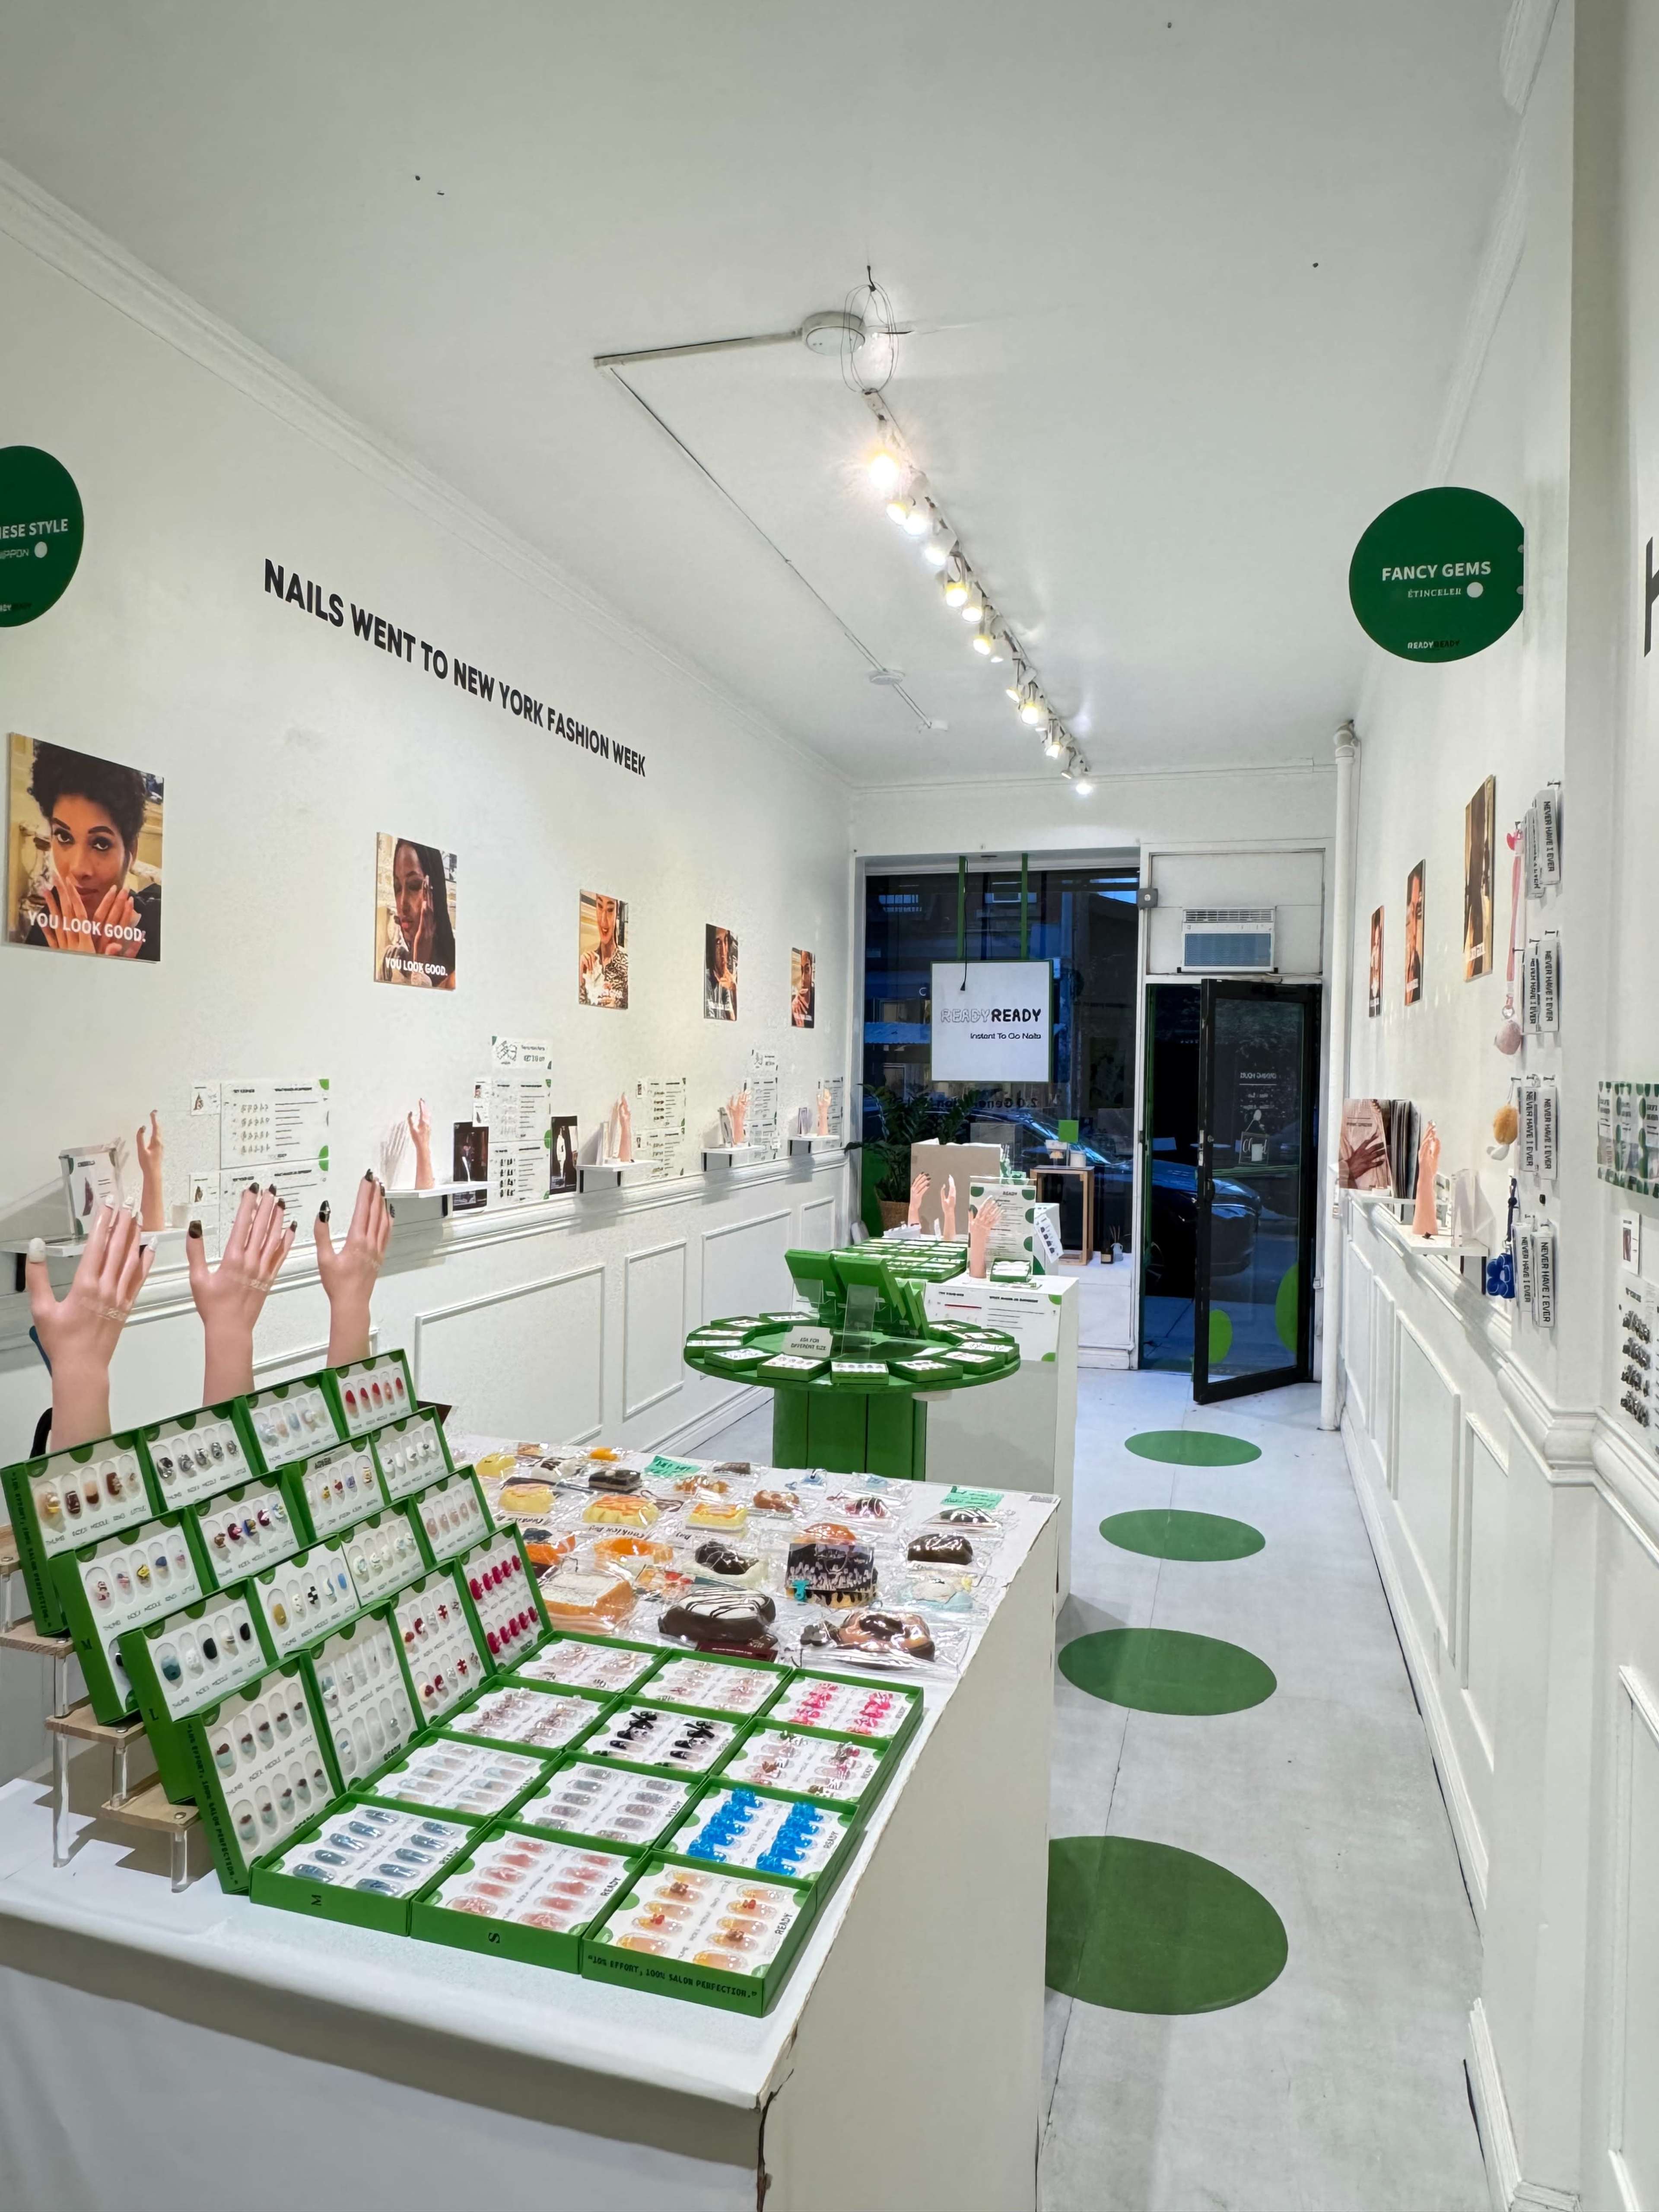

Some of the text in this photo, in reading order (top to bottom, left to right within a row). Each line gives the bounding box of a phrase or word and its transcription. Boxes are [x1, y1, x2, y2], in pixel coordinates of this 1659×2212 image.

[0, 518, 68, 539] ESE STYLE
[1382, 561, 1491, 581] FANCY GEMS
[264, 558, 645, 777] NAILS WENT TO NEW YORK FASHION WEEK
[28, 911, 58, 929] YOU
[63, 916, 101, 935] LOOK
[385, 957, 402, 970] YOU
[403, 960, 424, 973] LOOK
[1541, 1242, 1549, 1269] NEVER
[1542, 1301, 1551, 1322] EVER
[149, 1708, 159, 1721] L
[601, 1877, 621, 1896] READY
[311, 1894, 322, 1906] M
[775, 1913, 793, 1935] READY
[488, 1932, 500, 1943] S
[669, 1974, 693, 1986] SALON
